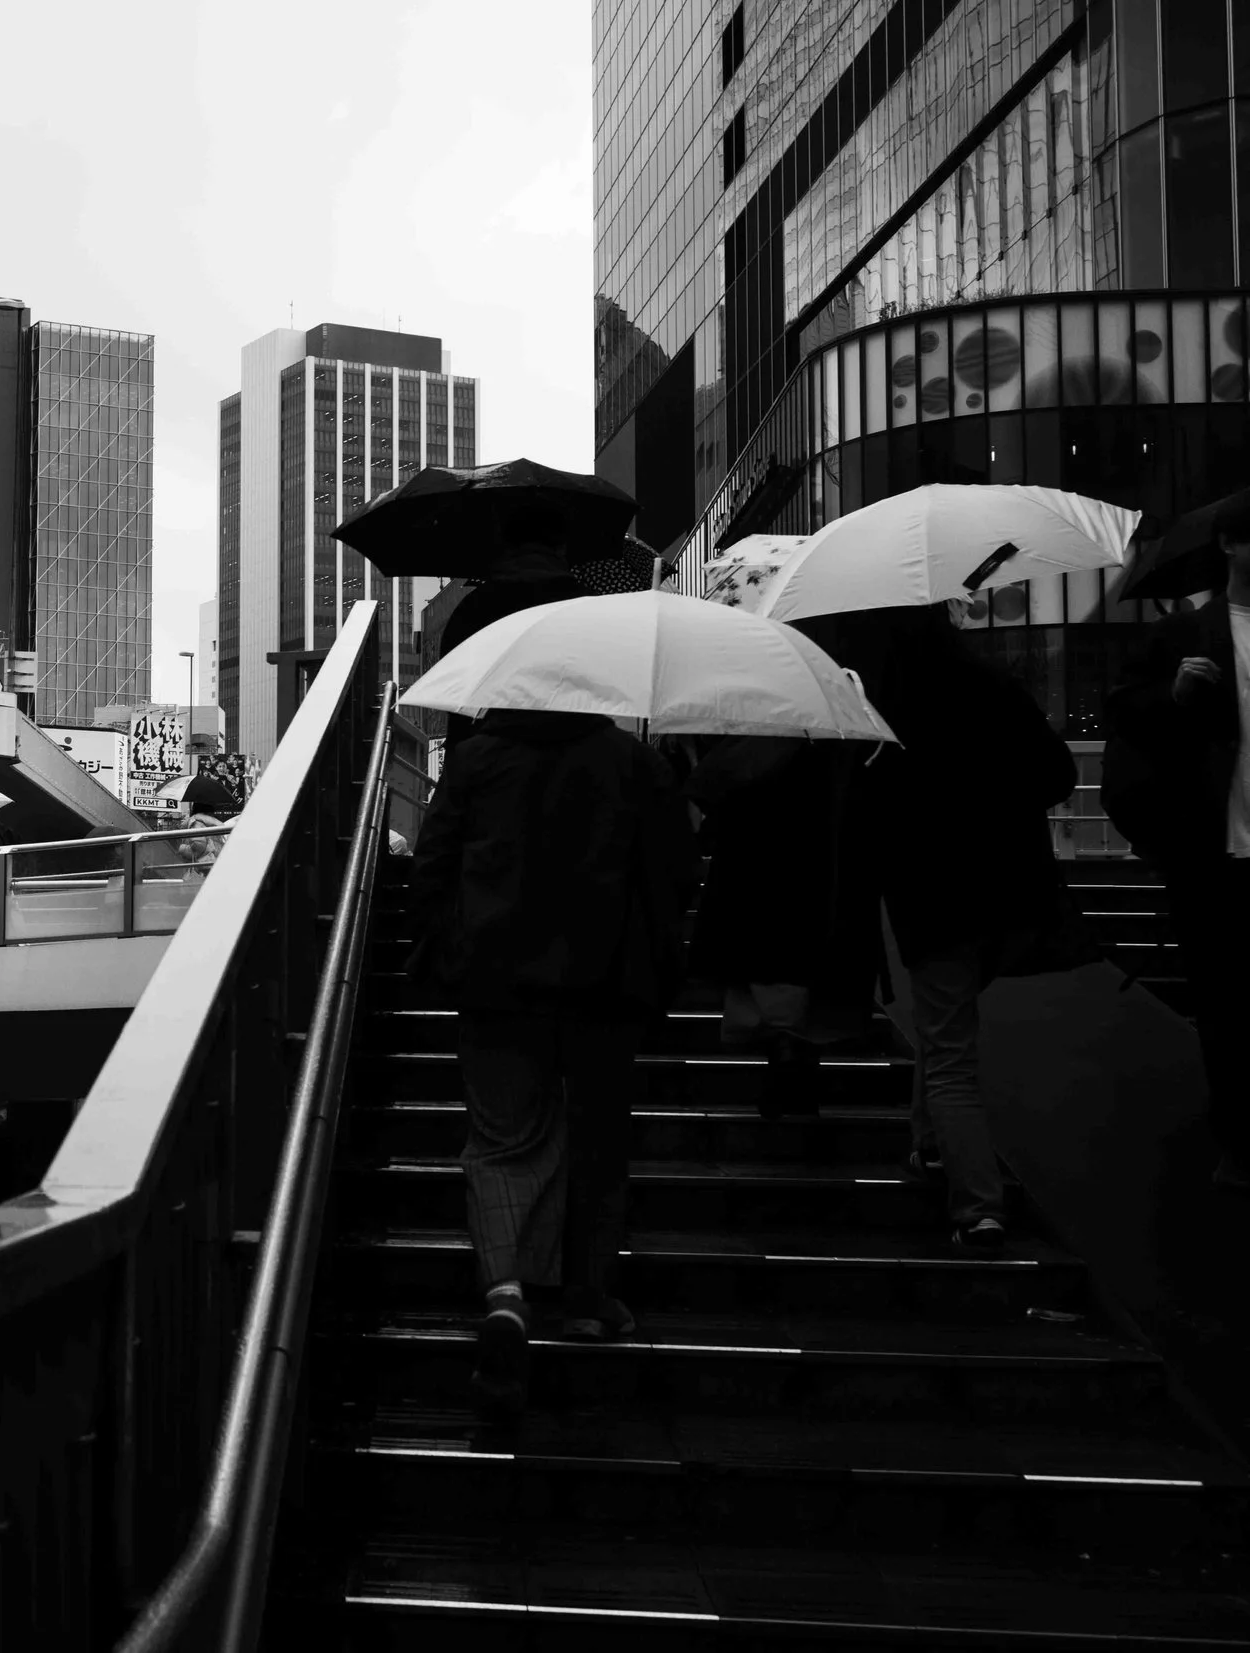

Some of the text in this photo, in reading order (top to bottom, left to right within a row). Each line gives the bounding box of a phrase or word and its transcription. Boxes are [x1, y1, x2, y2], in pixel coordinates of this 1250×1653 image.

[134, 715, 183, 744] 小林
[133, 741, 184, 772] 機械
[136, 798, 159, 806] KKMT
